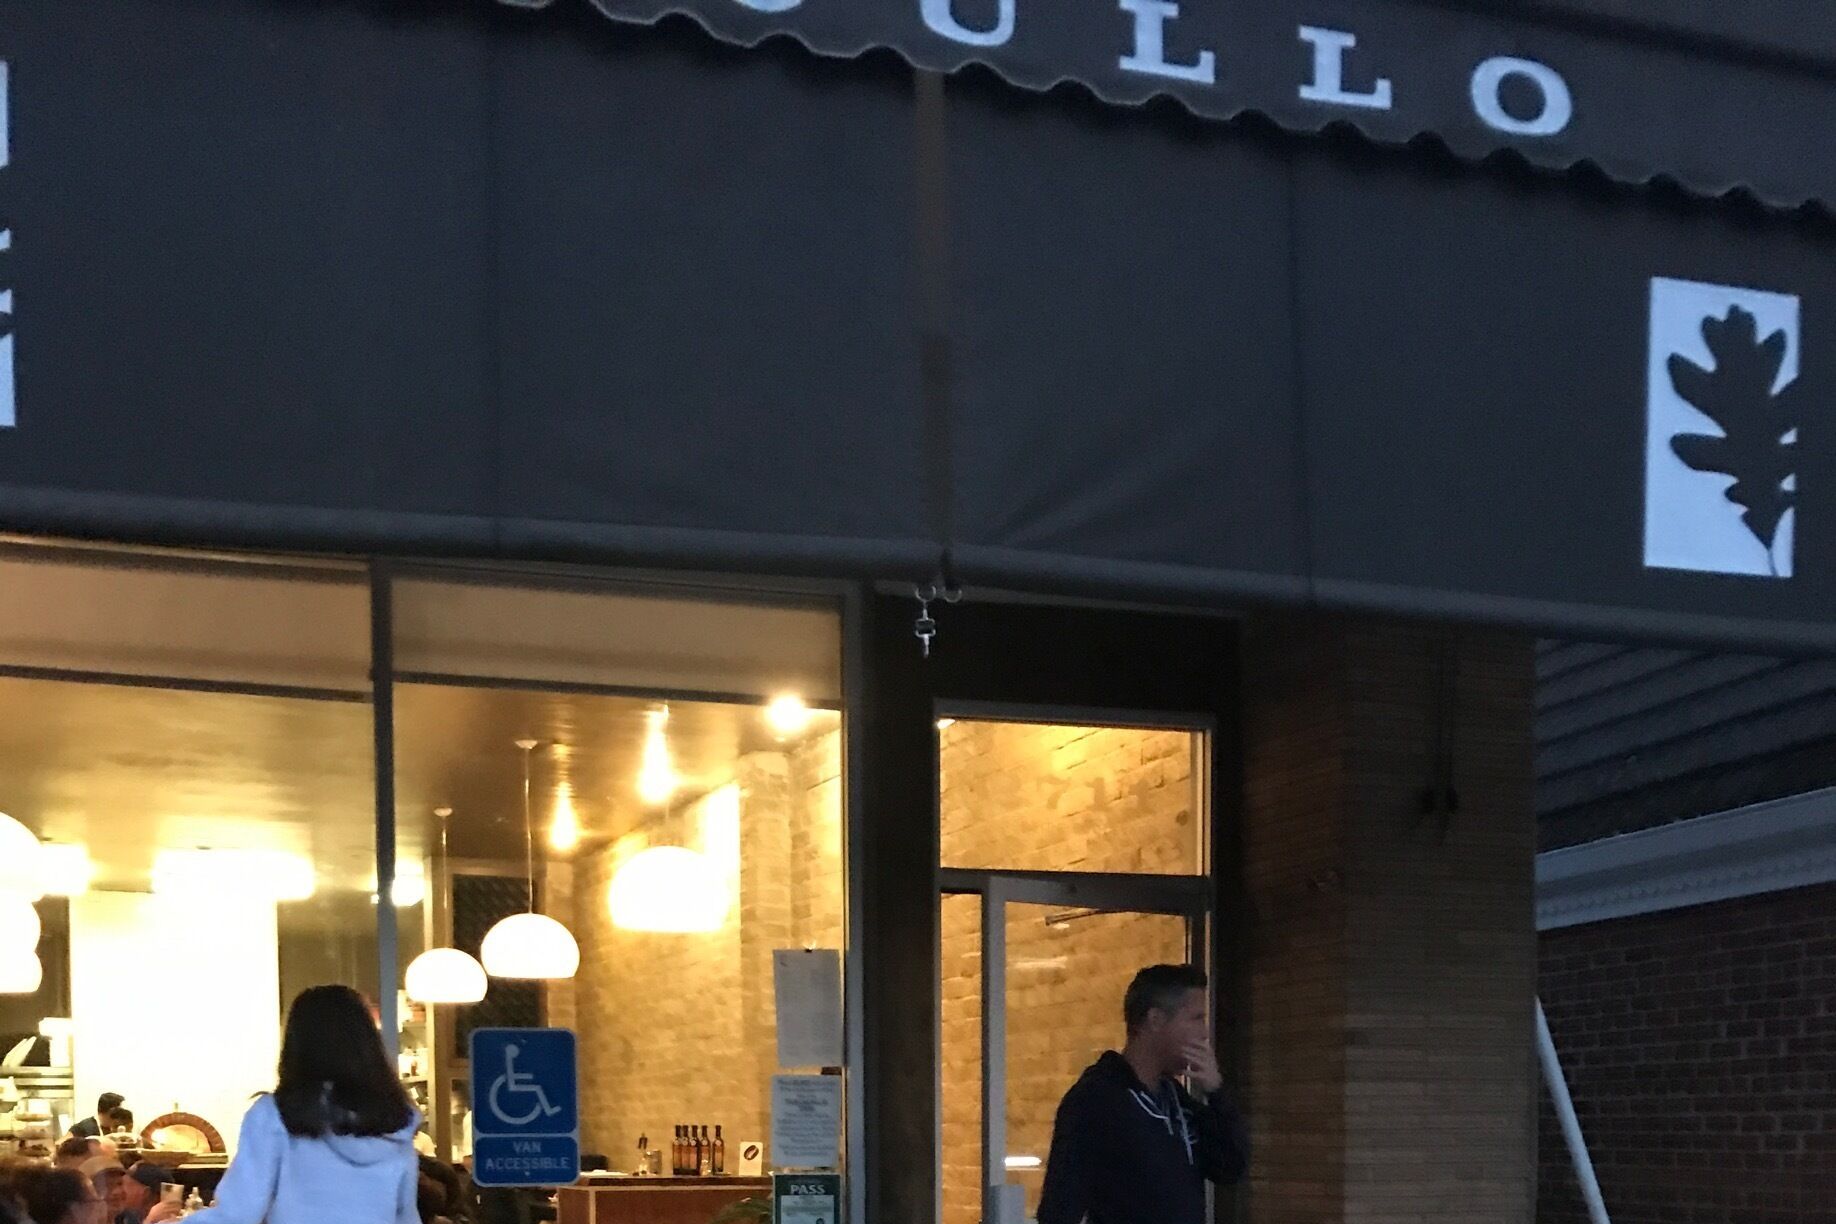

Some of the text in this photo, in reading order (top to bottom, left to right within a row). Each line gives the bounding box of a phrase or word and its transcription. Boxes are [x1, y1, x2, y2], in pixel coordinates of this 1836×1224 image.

[738, 0, 1572, 136] ULLO
[512, 1140, 542, 1153] VAN
[485, 1157, 570, 1171] ACCESSIBLE
[790, 1184, 826, 1195] PASS
